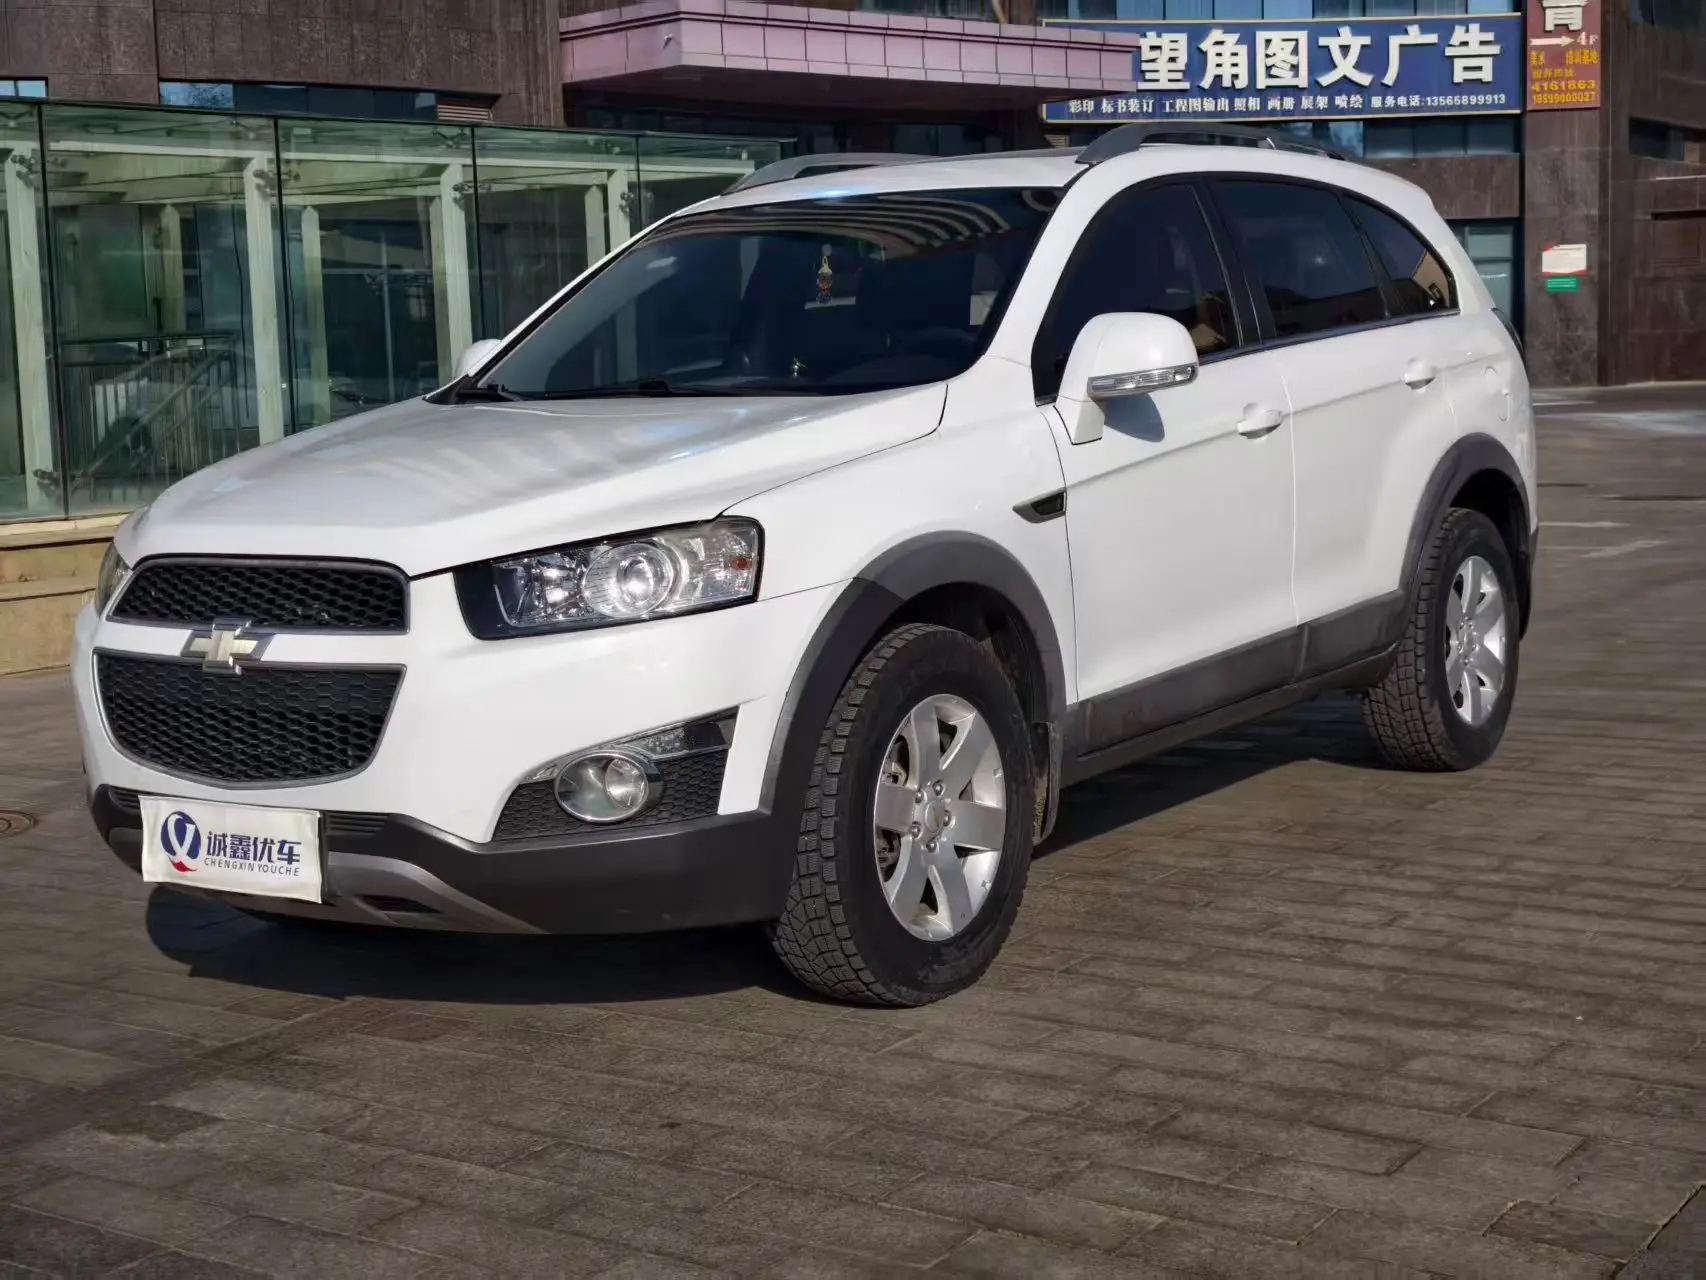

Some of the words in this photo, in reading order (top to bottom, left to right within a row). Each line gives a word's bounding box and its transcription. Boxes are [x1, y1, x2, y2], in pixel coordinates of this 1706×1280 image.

[1137, 23, 1501, 90] 望角图文广告
[1532, 79, 1596, 91] 4161863
[1068, 98, 1094, 113] 彩印
[1101, 98, 1154, 113] 标书装订
[1162, 98, 1230, 113] 工程图输出
[1234, 97, 1261, 111] 照相
[1300, 96, 1328, 109] 展架
[1335, 95, 1363, 108] 喷绘
[206, 830, 302, 866] 诚鑫优车
[204, 858, 254, 872] CHENGXIN
[258, 863, 300, 877] YOUCHE
